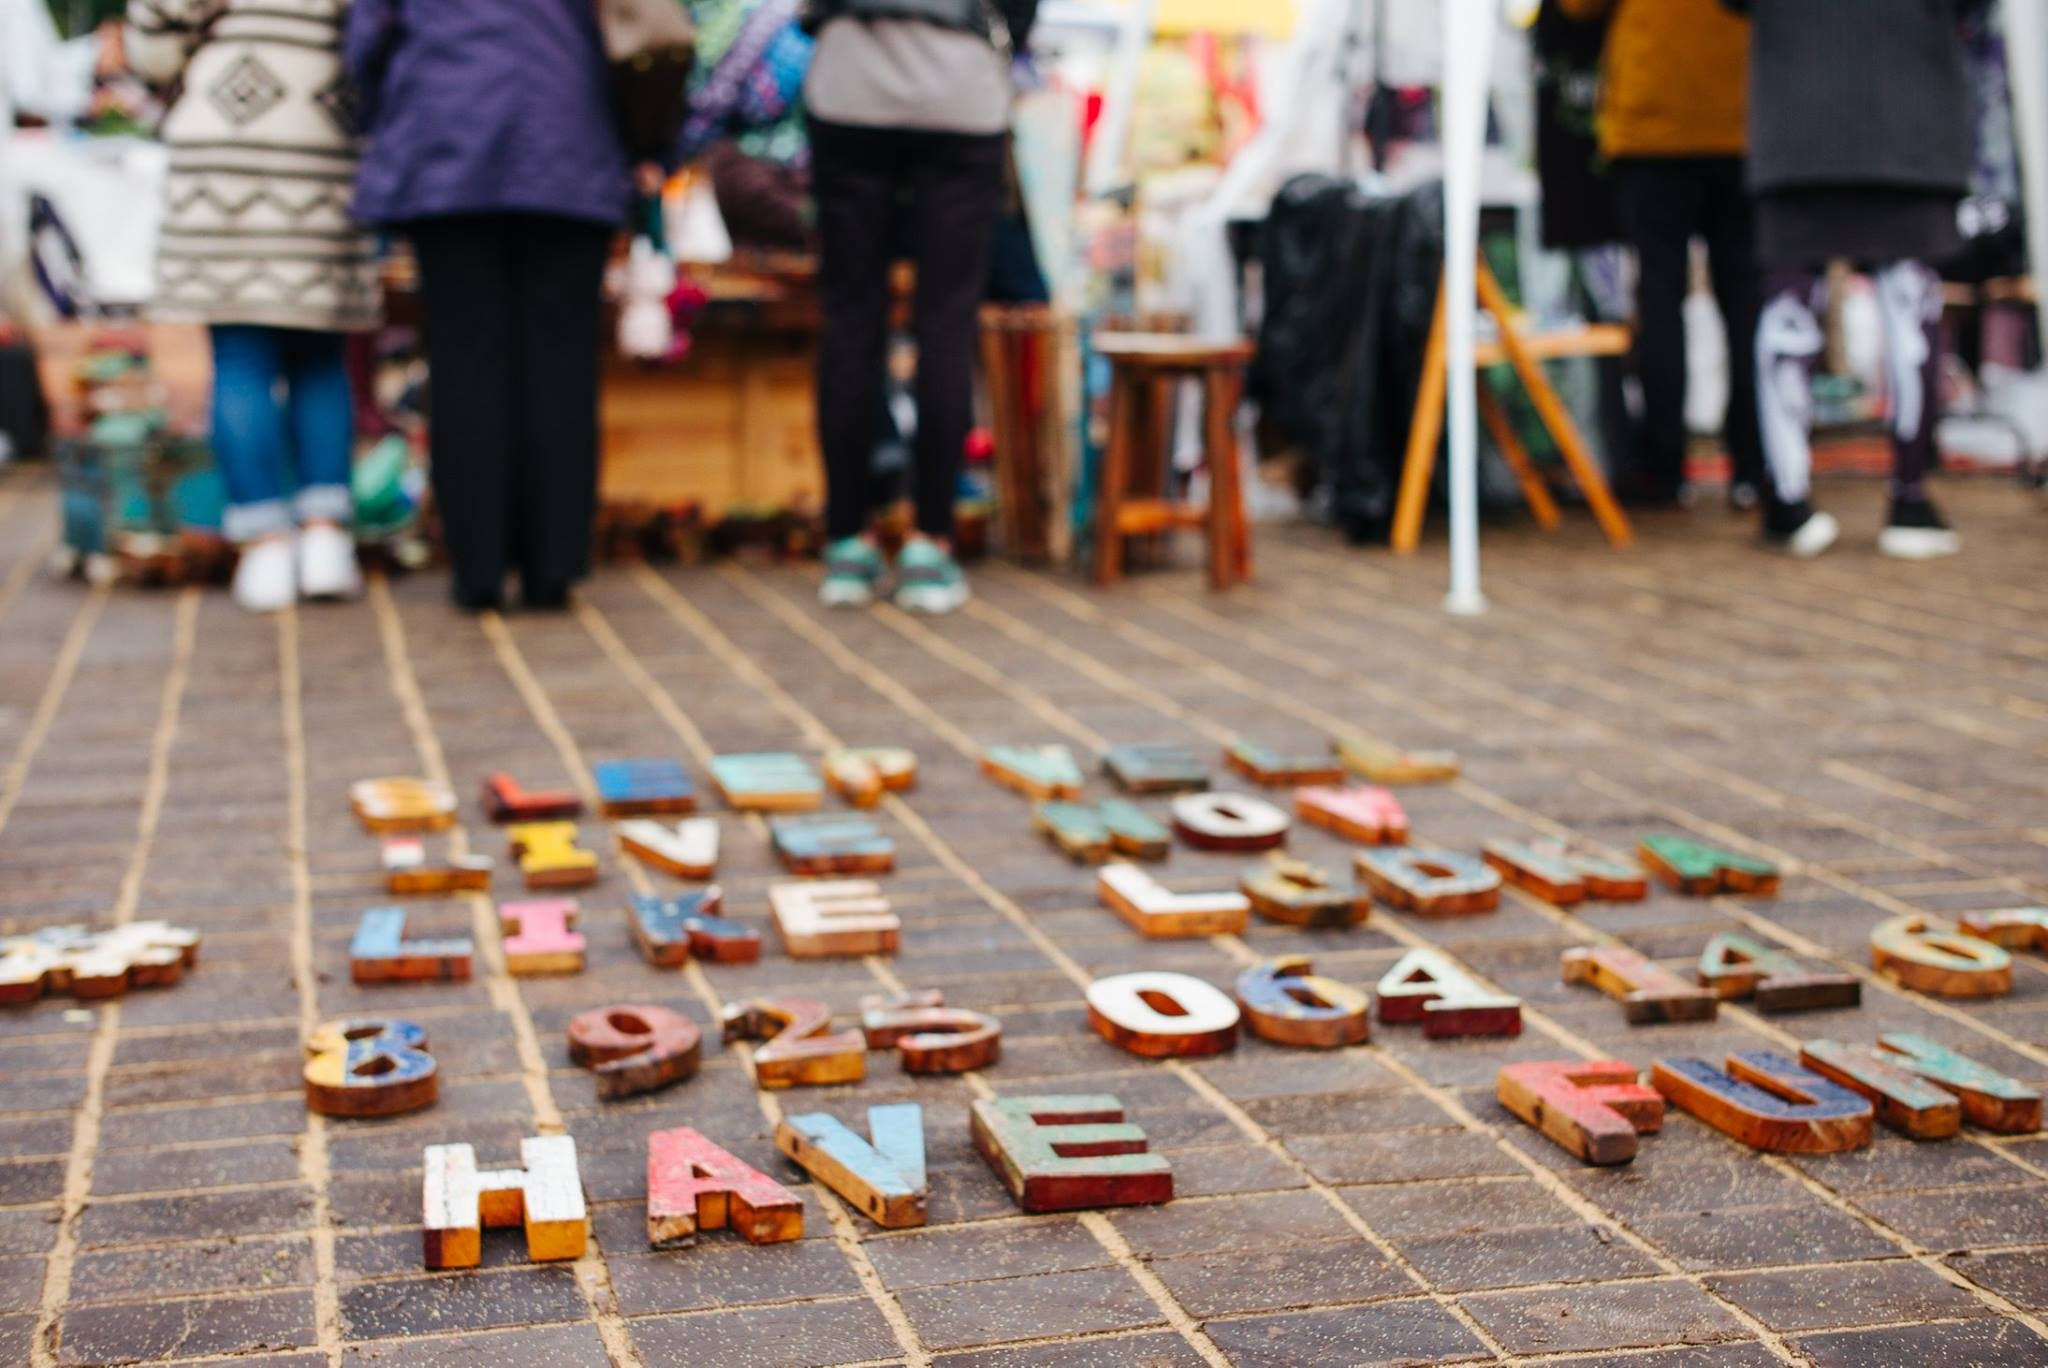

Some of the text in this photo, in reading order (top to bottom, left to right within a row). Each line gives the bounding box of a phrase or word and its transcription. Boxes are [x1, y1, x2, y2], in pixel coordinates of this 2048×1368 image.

[381, 810, 895, 896] LIVE
[351, 880, 901, 984] LIKE
[422, 1033, 2044, 1270] HAVE FUN
